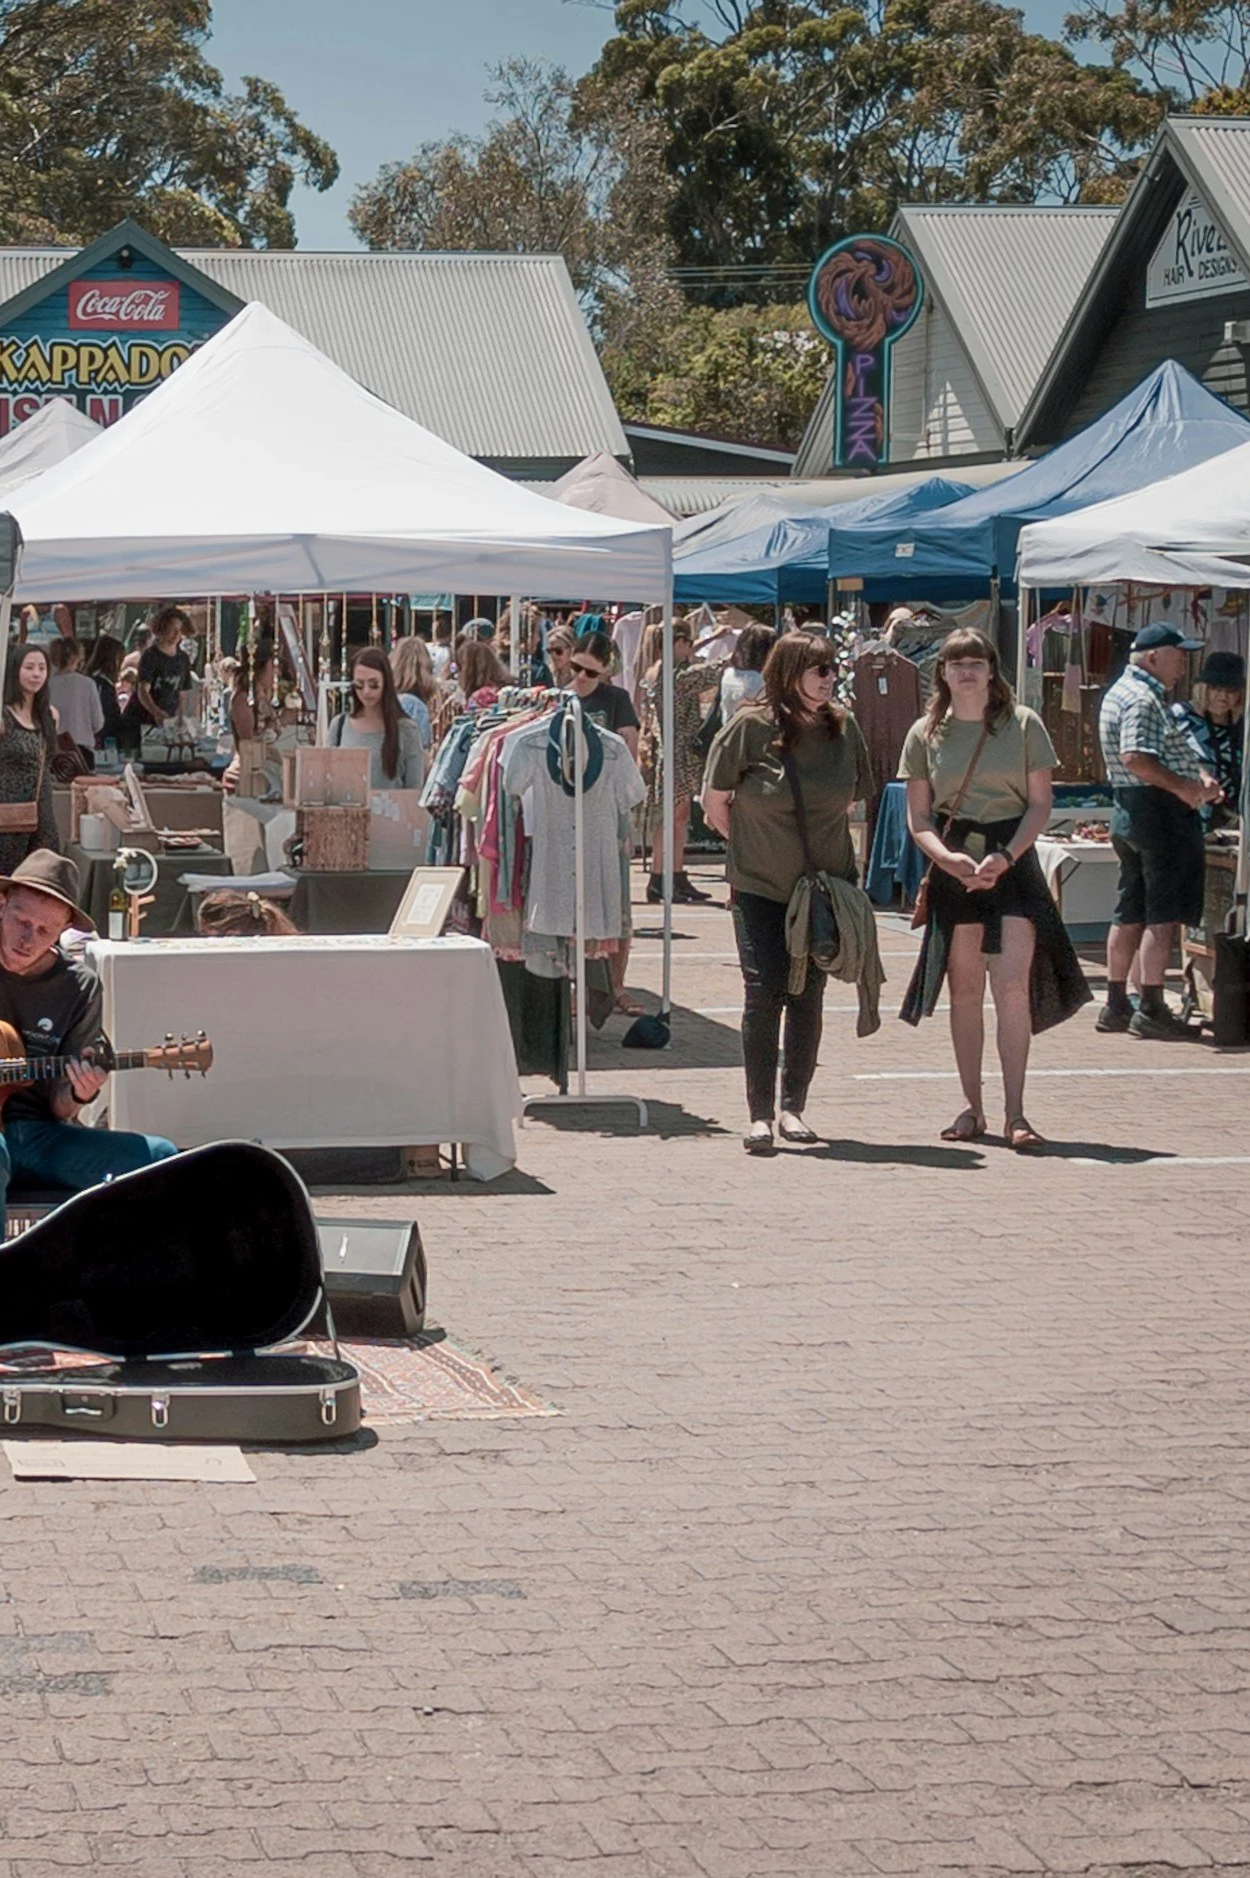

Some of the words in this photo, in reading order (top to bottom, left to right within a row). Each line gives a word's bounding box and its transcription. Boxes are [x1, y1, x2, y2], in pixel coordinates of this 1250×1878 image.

[1163, 265, 1185, 286] HAIR
[76, 289, 170, 321] Coca-Cola
[848, 354, 877, 461] PIZZA
